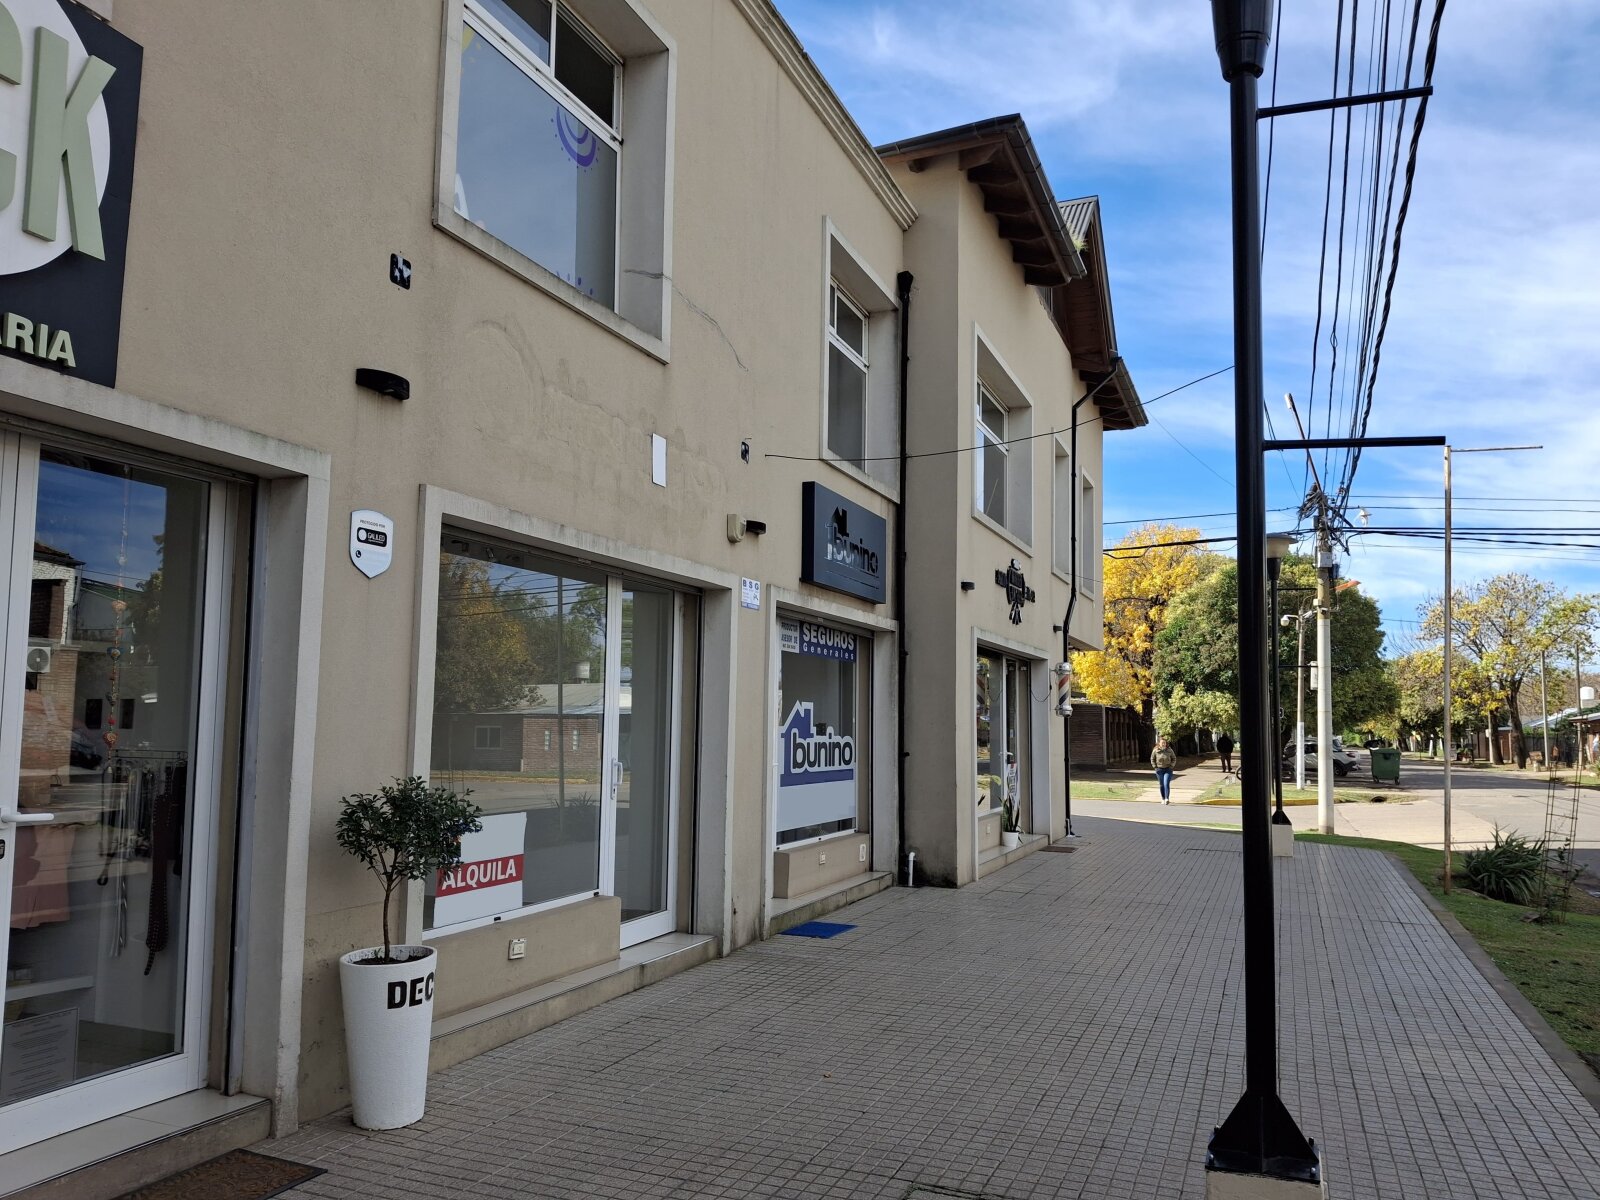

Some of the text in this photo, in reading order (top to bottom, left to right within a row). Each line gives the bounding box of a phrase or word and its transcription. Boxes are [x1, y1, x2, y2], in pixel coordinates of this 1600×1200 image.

[0, 311, 77, 368] RIA
[802, 622, 855, 651] SEGUROS
[802, 642, 854, 660] Generales
[793, 732, 852, 769] bunino
[441, 859, 517, 890] ALQUILA
